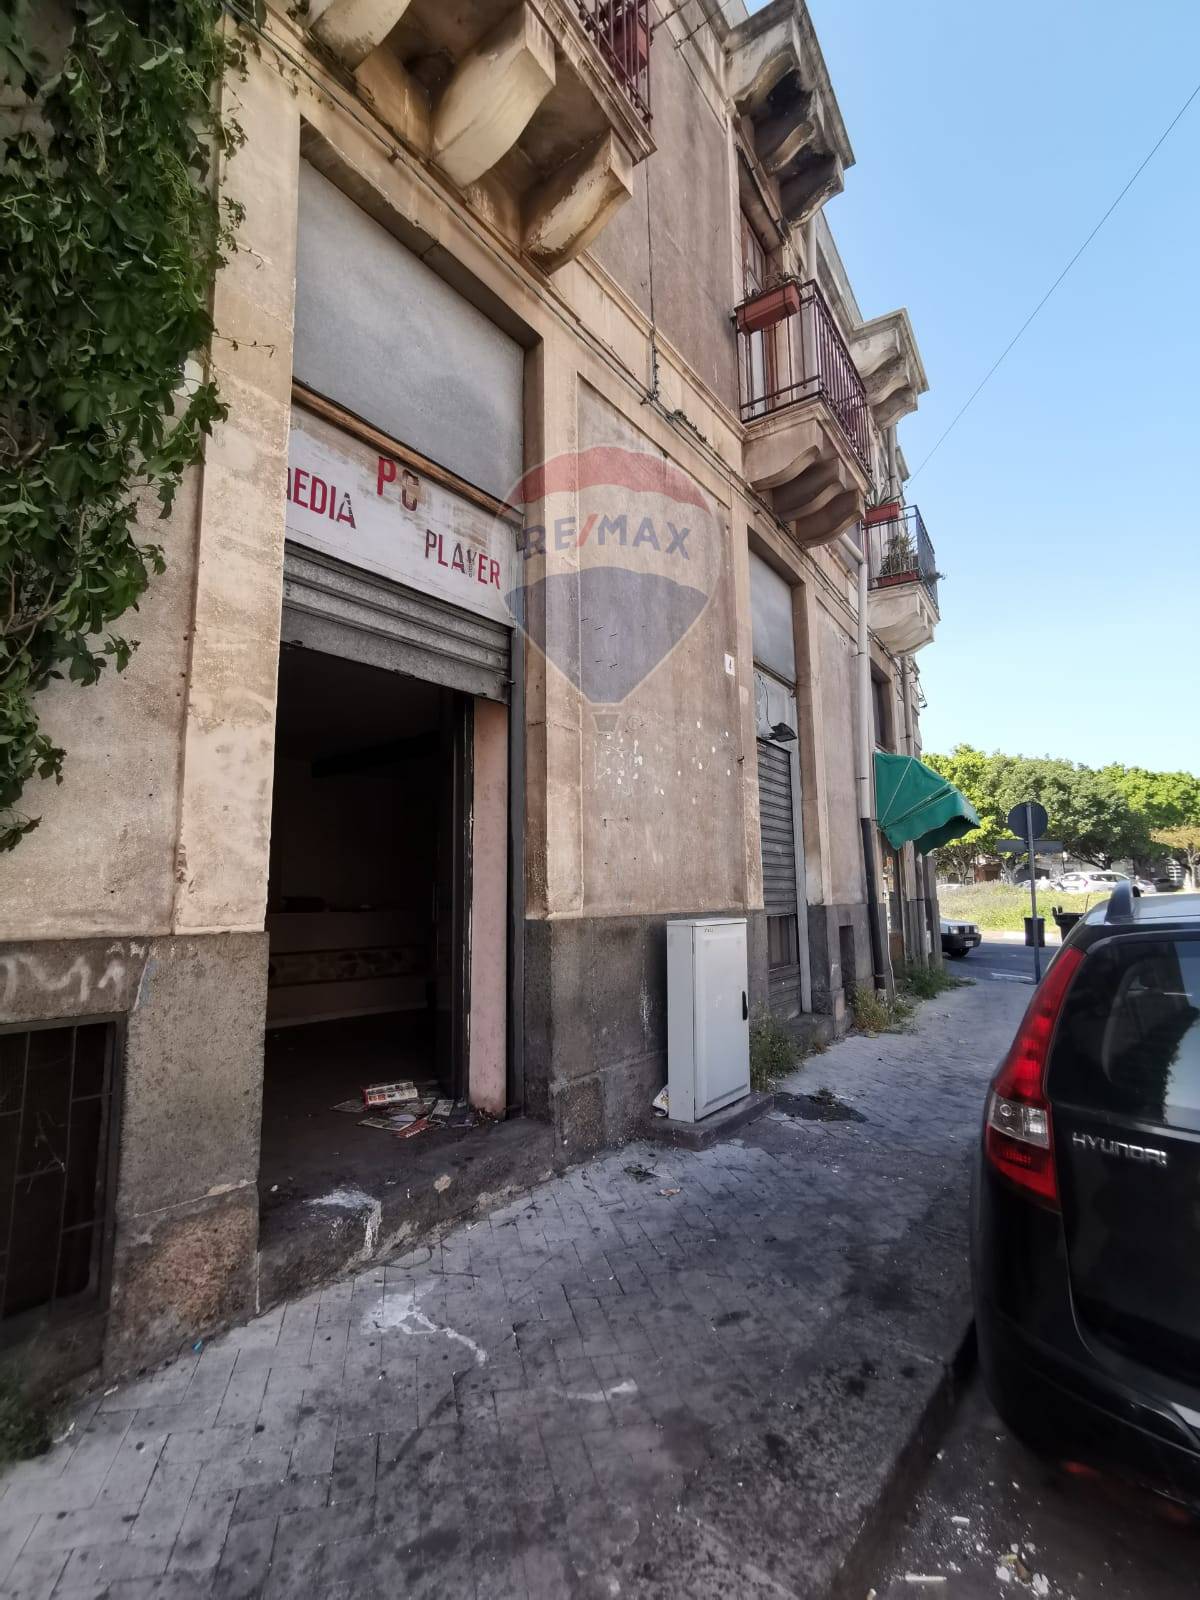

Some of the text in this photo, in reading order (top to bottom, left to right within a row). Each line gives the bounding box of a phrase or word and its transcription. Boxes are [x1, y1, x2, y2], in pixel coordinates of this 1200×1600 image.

[287, 467, 500, 590] EDIA PLAYER
[1072, 1131, 1168, 1168] HYUNDAI
